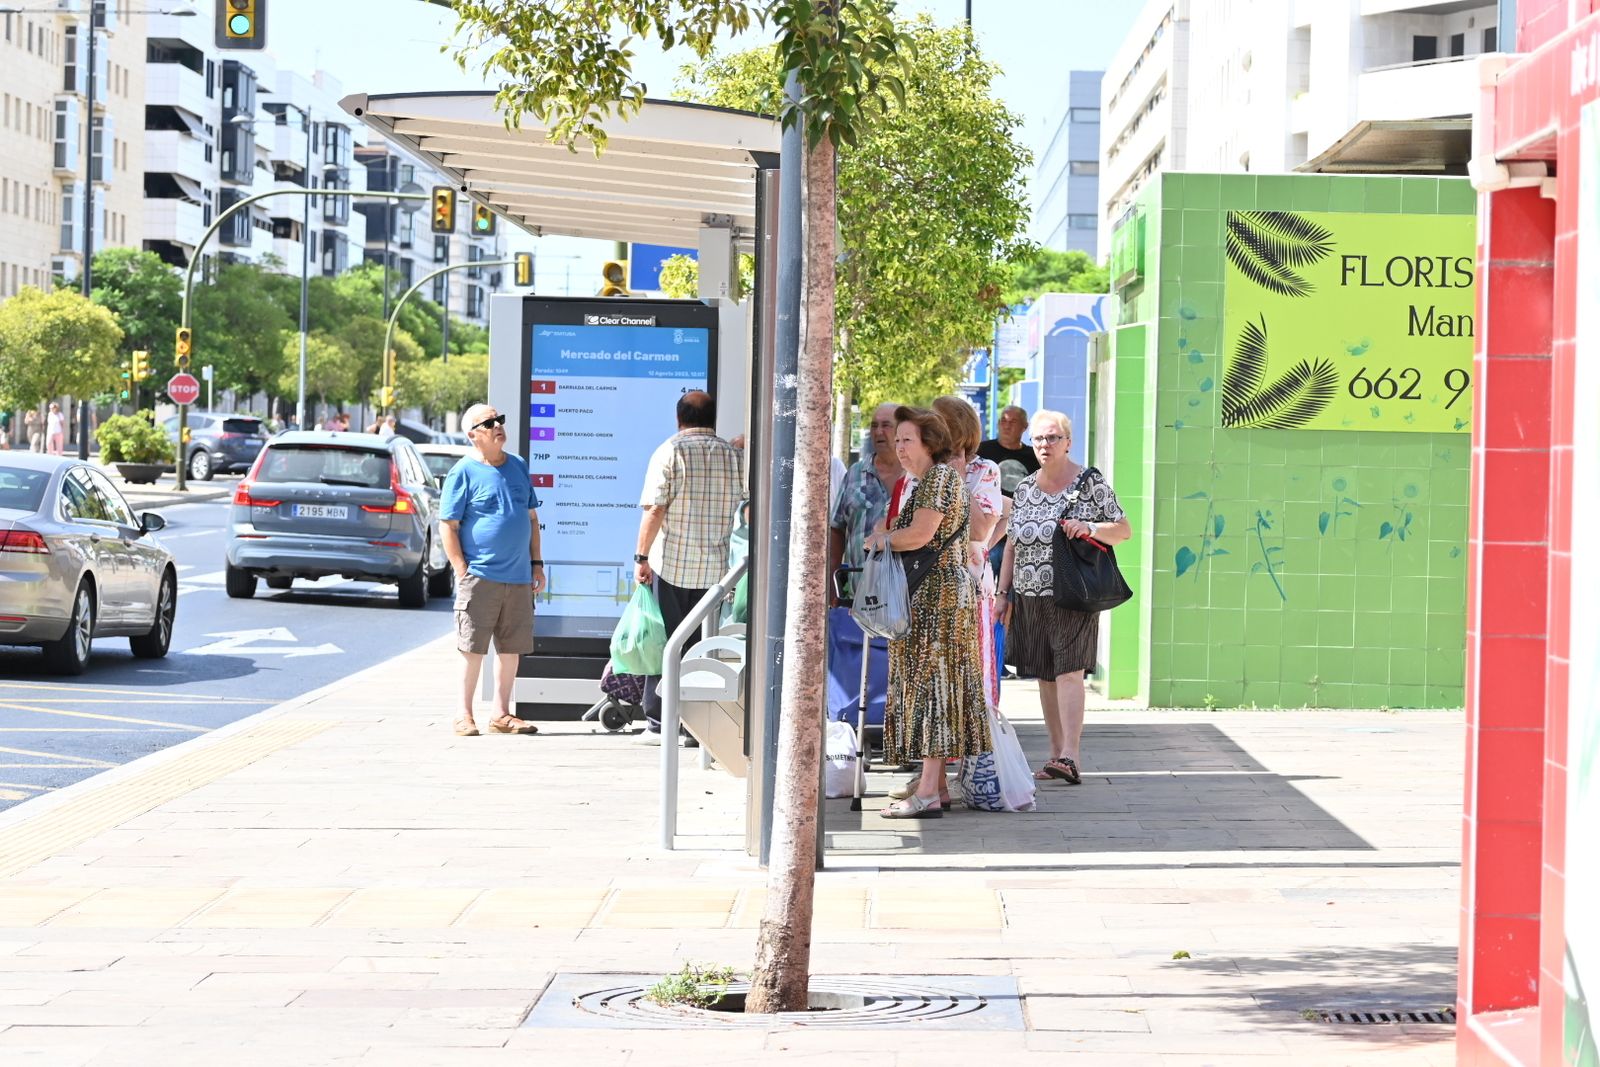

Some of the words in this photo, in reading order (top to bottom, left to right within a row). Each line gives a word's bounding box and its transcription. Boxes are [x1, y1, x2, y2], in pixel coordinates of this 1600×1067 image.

[1341, 255, 1473, 288] FLORIS
[600, 316, 620, 325] Clear
[621, 317, 652, 326] Channel
[1407, 305, 1474, 337] Man
[560, 349, 611, 360] Mercado
[613, 350, 632, 360] del
[633, 351, 680, 361] Carmen
[170, 385, 197, 394] STOP
[540, 383, 546, 391] 1
[1348, 367, 1422, 400] 662
[1444, 368, 1470, 410] 9
[538, 476, 545, 484] 1
[299, 506, 324, 517] 2195
[327, 508, 346, 518] MBN
